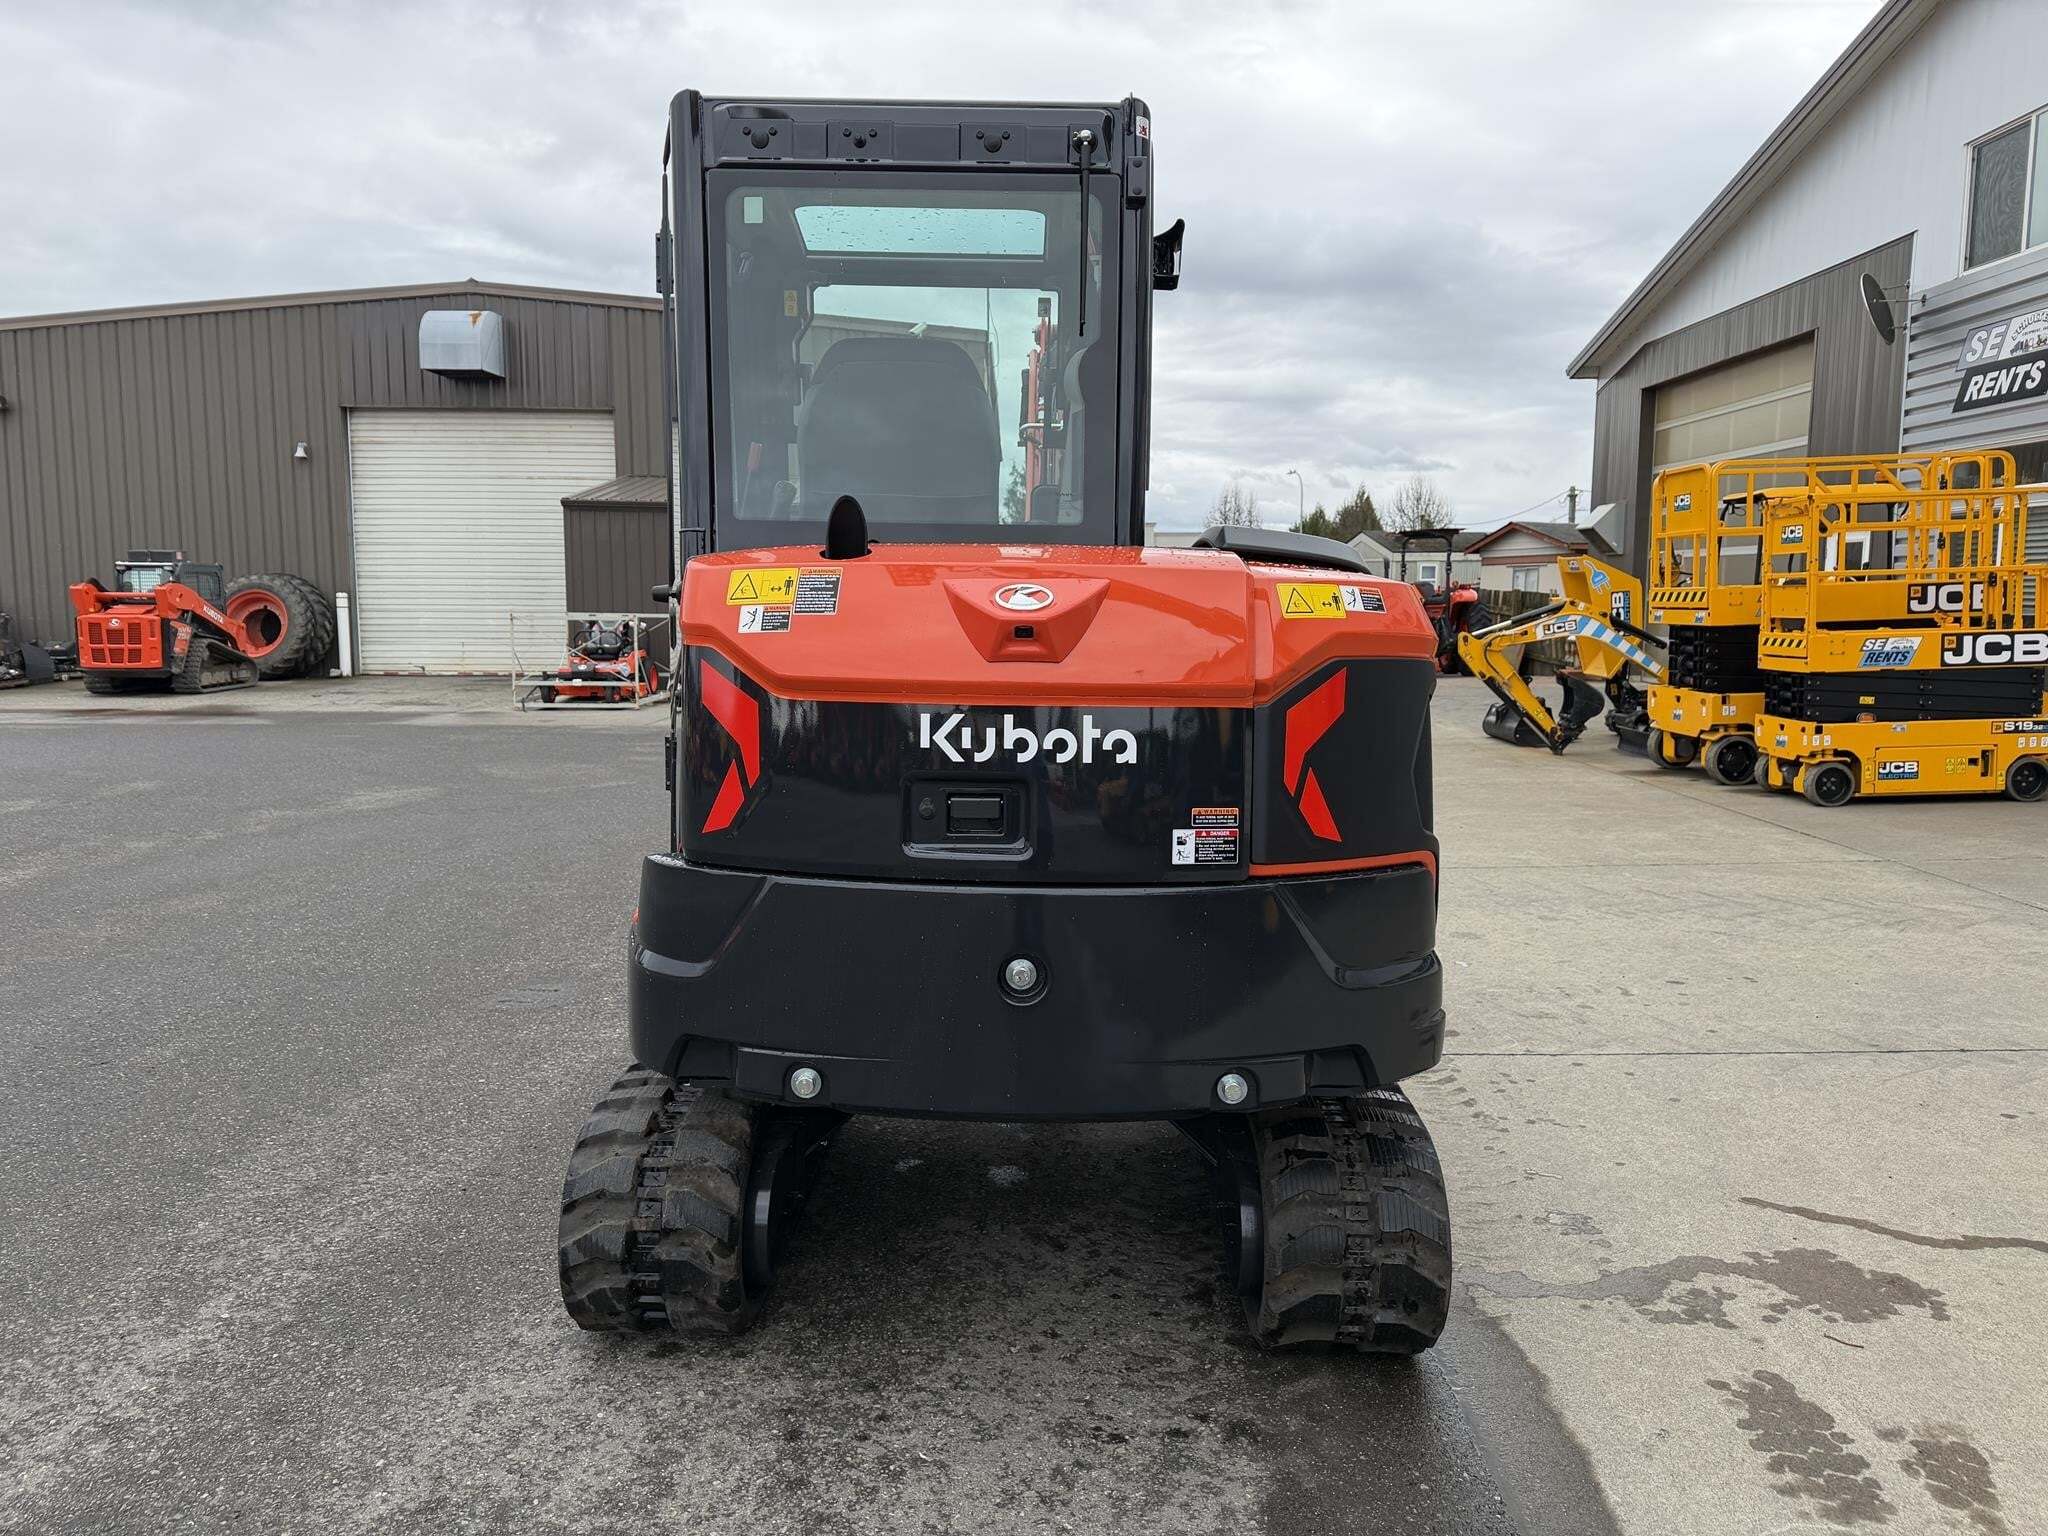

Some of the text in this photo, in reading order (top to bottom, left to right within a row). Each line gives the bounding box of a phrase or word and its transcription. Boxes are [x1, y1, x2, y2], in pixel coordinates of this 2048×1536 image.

[1966, 325, 2007, 362] SE
[1963, 360, 2046, 402] RENTS
[1674, 495, 1691, 506] JCB
[1782, 525, 1803, 538] JCB
[1546, 621, 1578, 634] JCB
[1862, 639, 1887, 651] SE
[1943, 633, 2048, 665] JCB
[1864, 651, 1911, 664] RENTS
[919, 713, 1138, 764] Kubota
[1878, 762, 1919, 773] JCB
